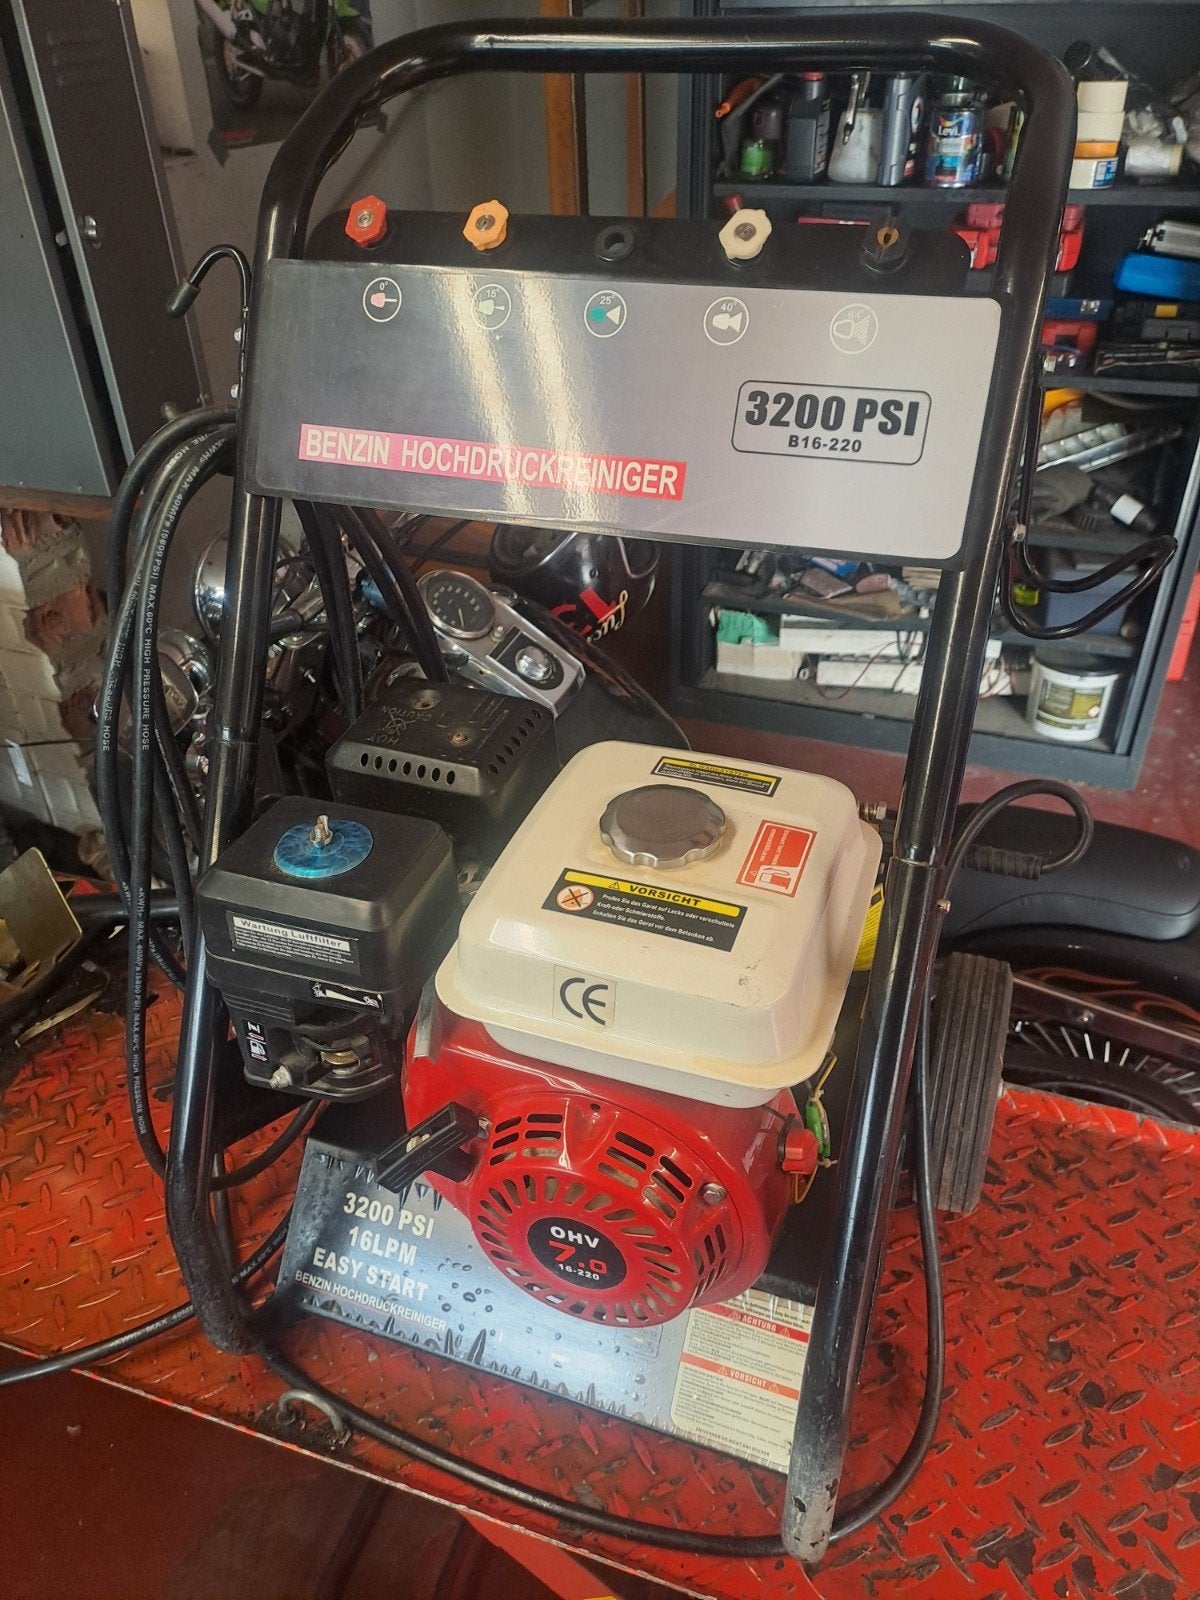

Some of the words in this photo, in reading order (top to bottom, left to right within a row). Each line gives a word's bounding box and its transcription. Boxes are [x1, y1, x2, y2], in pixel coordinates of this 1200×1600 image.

[486, 288, 500, 298] 15°
[600, 295, 615, 306] 25°
[720, 300, 737, 312] 40°
[745, 390, 846, 431] 3200
[852, 397, 920, 437] PSI
[787, 434, 863, 453] B16-220
[306, 428, 390, 465] BENZIN
[401, 438, 679, 496] HOCHDRUCKREINIGER
[164, 493, 183, 528] 40MPa
[150, 558, 162, 580] PSI)
[145, 583, 158, 634] MAX.60°C
[144, 638, 152, 664] HIGH
[142, 668, 151, 720] PRESSURE
[102, 725, 111, 752] HOSE
[142, 723, 150, 751] HOSE
[629, 884, 702, 908] VORSICHT
[241, 919, 288, 938] Wartung
[291, 929, 343, 948] Luftfilter
[559, 977, 609, 1026] CE
[132, 1053, 140, 1073] HIGH
[133, 1075, 143, 1113] PRESSURE
[138, 1114, 147, 1135] HOSE
[343, 1192, 395, 1226] 3200
[398, 1209, 435, 1240] PSI
[349, 1225, 418, 1266] 16LPM
[550, 1226, 600, 1249] OHV
[548, 1239, 608, 1275] 7.0
[312, 1247, 364, 1279] EASY
[366, 1264, 429, 1302] START
[558, 1263, 600, 1281] 16-220
[295, 1270, 332, 1292] BENZIN
[332, 1280, 447, 1333] HOCHDRUCKREINIGER
[742, 1315, 777, 1333] ACHTUNG
[730, 1369, 768, 1388] VORSICHT
